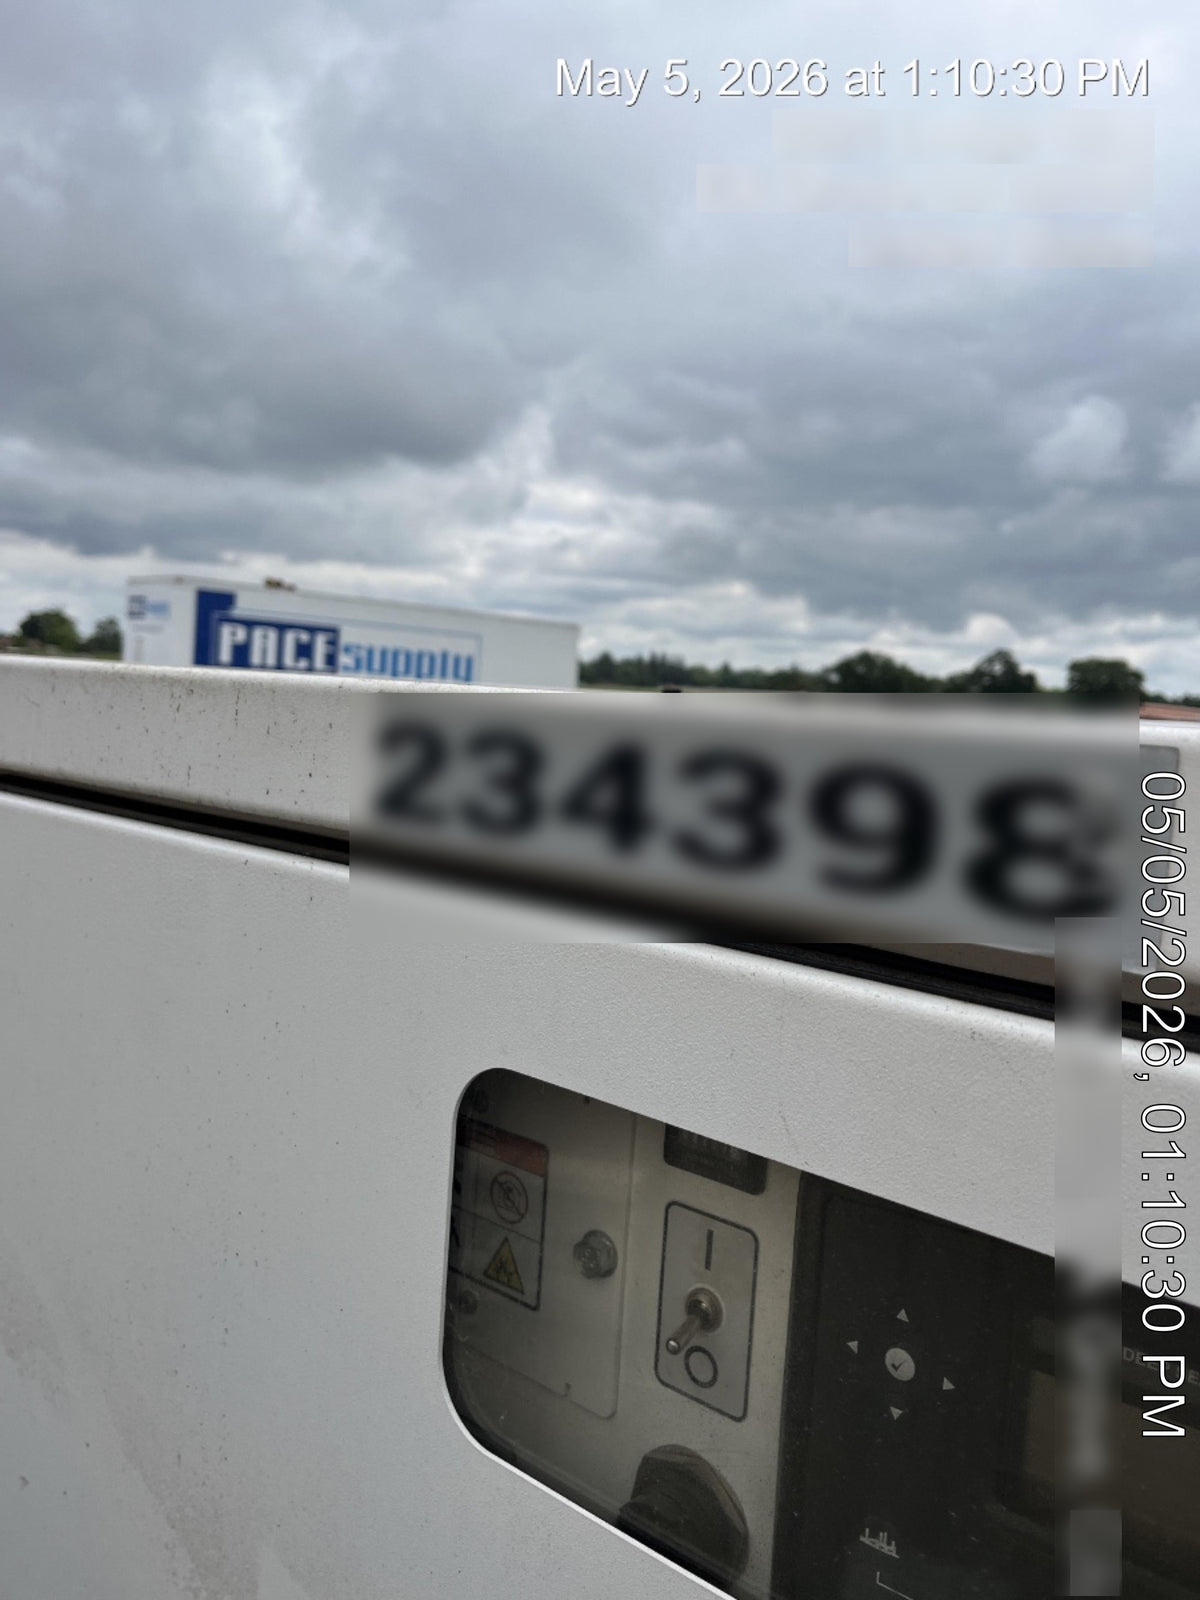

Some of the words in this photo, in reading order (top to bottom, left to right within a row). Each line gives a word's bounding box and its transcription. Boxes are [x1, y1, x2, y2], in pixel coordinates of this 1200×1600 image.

[219, 622, 337, 672] PACE
[341, 642, 475, 683] supply
[376, 720, 1114, 919] 234398
